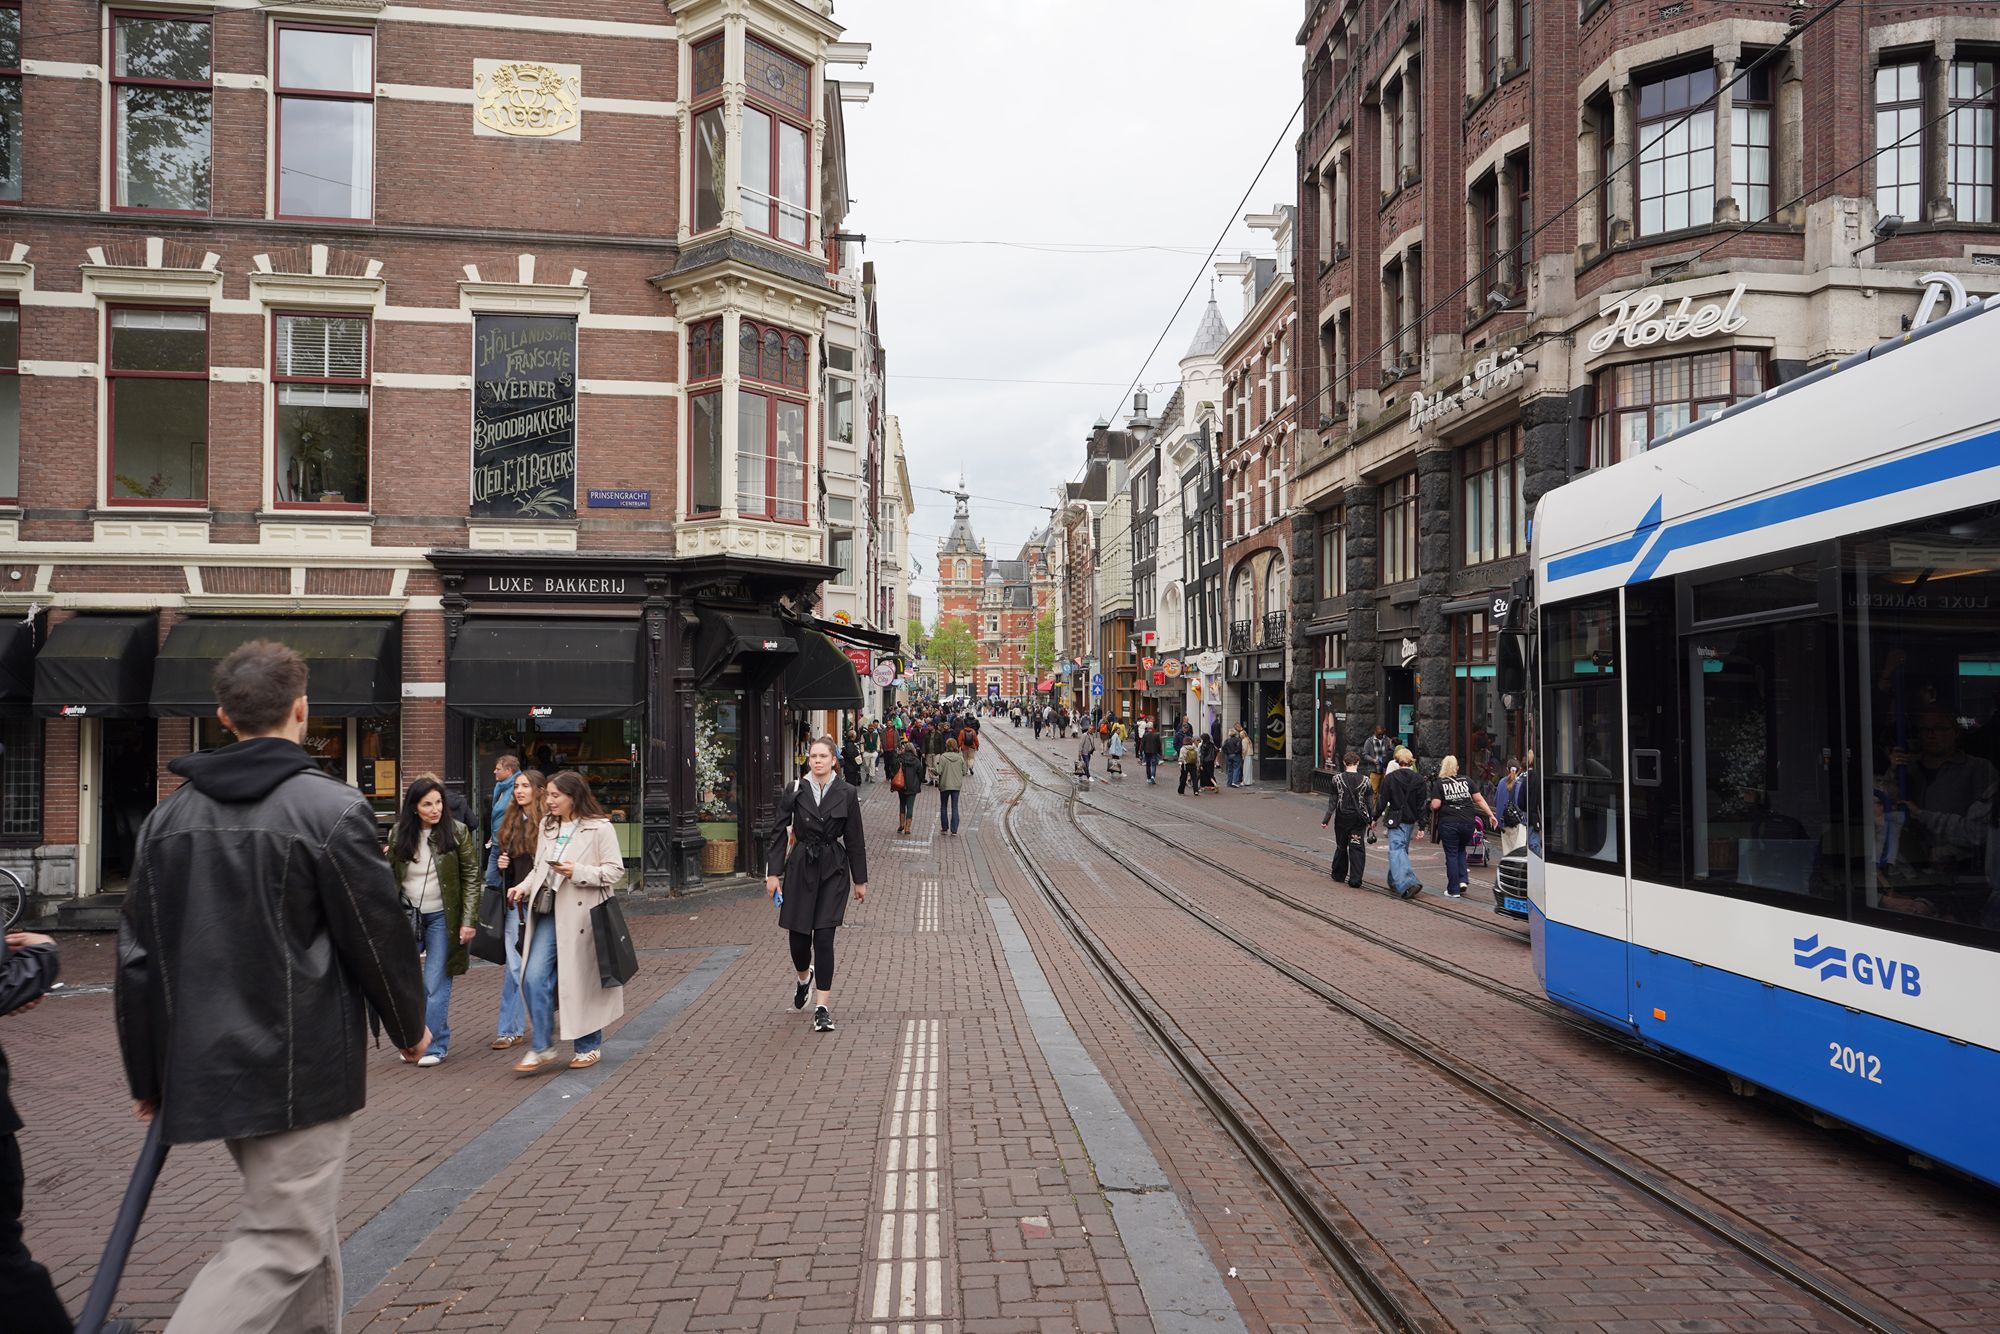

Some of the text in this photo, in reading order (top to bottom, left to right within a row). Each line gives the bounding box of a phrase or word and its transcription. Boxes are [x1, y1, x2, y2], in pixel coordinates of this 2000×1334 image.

[1588, 277, 1750, 353] Hotel
[505, 346, 571, 379] FRANSCHE
[484, 371, 573, 402] WEENER &
[473, 402, 576, 451] BROODBAKKERIJ
[590, 491, 648, 500] PRINSENGRACHT
[489, 577, 625, 594] LUXE BAKKERIJ
[1442, 780, 1469, 795] PARIS
[1852, 952, 1921, 997] GVB
[1829, 1042, 1882, 1084] 2012
